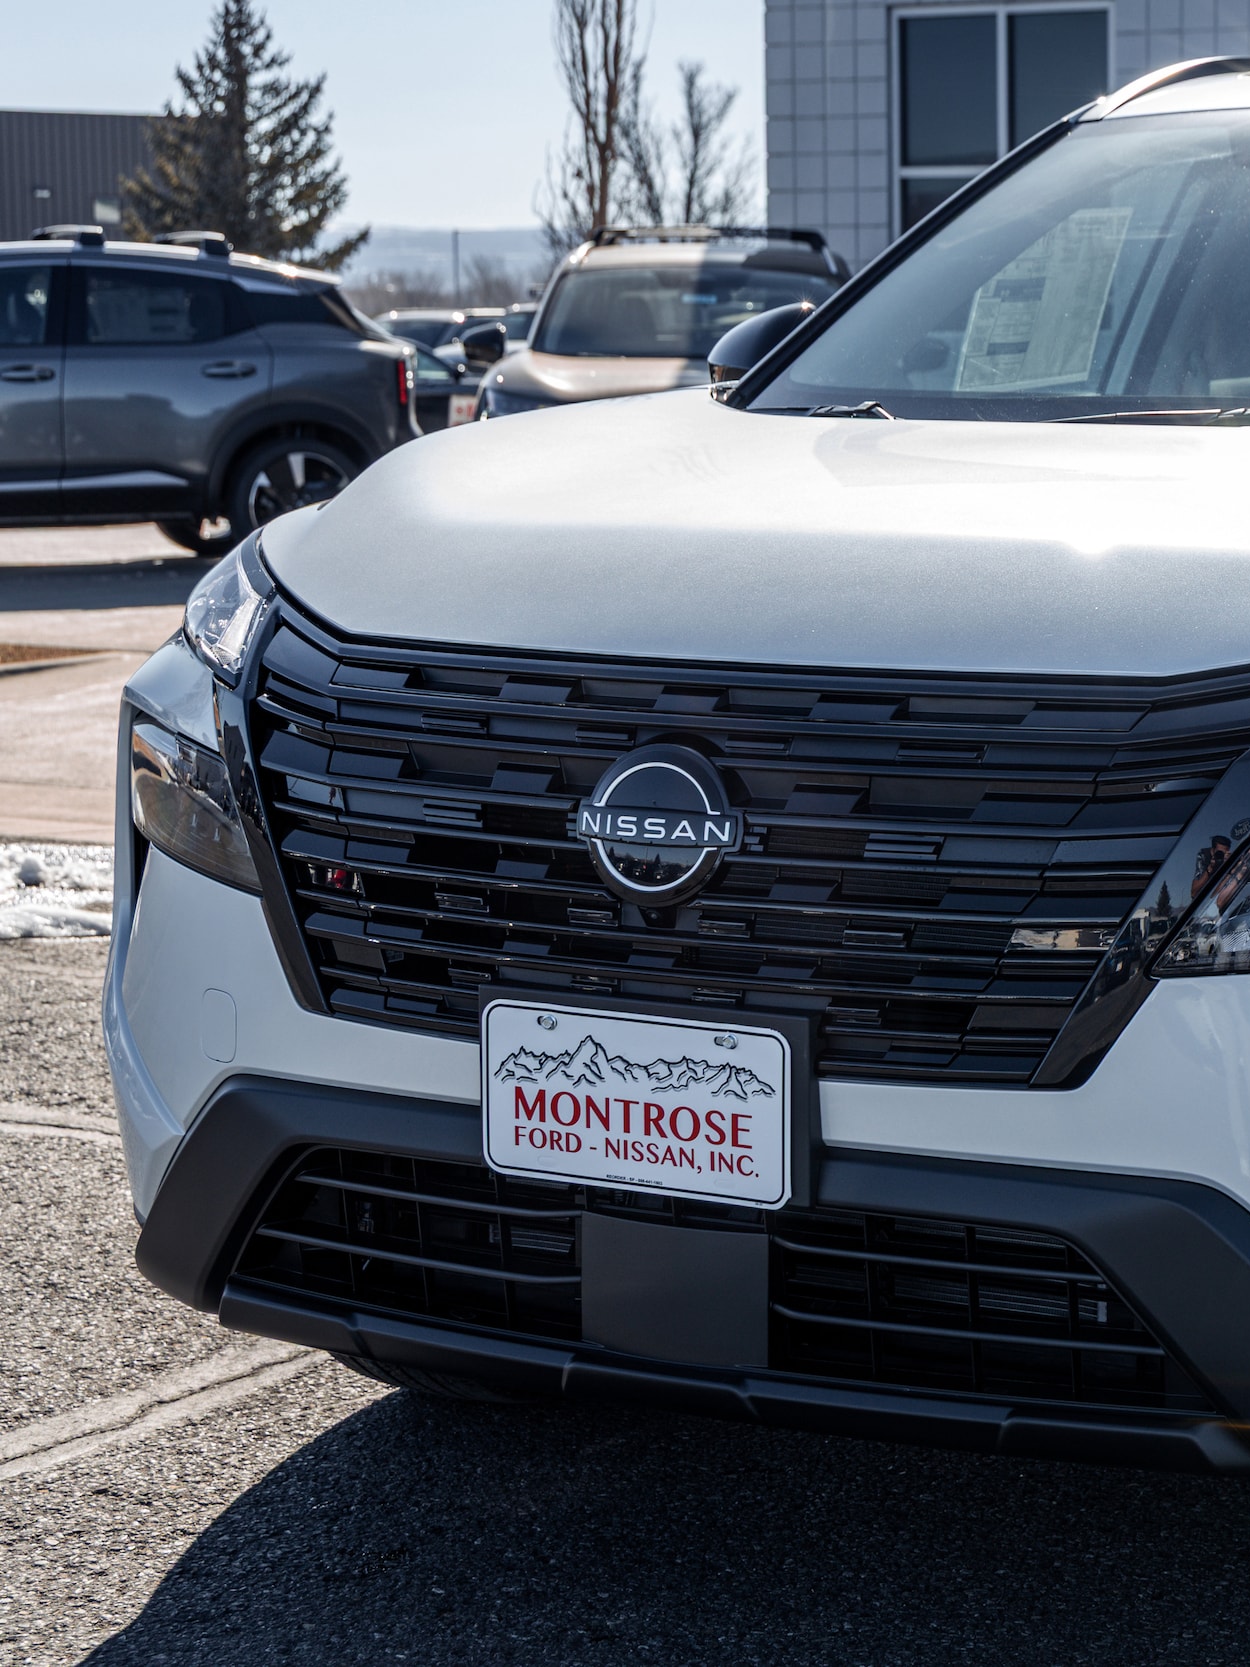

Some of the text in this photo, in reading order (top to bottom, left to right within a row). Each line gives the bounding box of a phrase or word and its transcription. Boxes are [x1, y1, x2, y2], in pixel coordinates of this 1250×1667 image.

[582, 811, 731, 842] NISSAN
[514, 1086, 753, 1149] MONTROSE
[514, 1126, 582, 1153] FORD
[604, 1138, 703, 1175] NISSAN,
[709, 1151, 759, 1178] INC.
